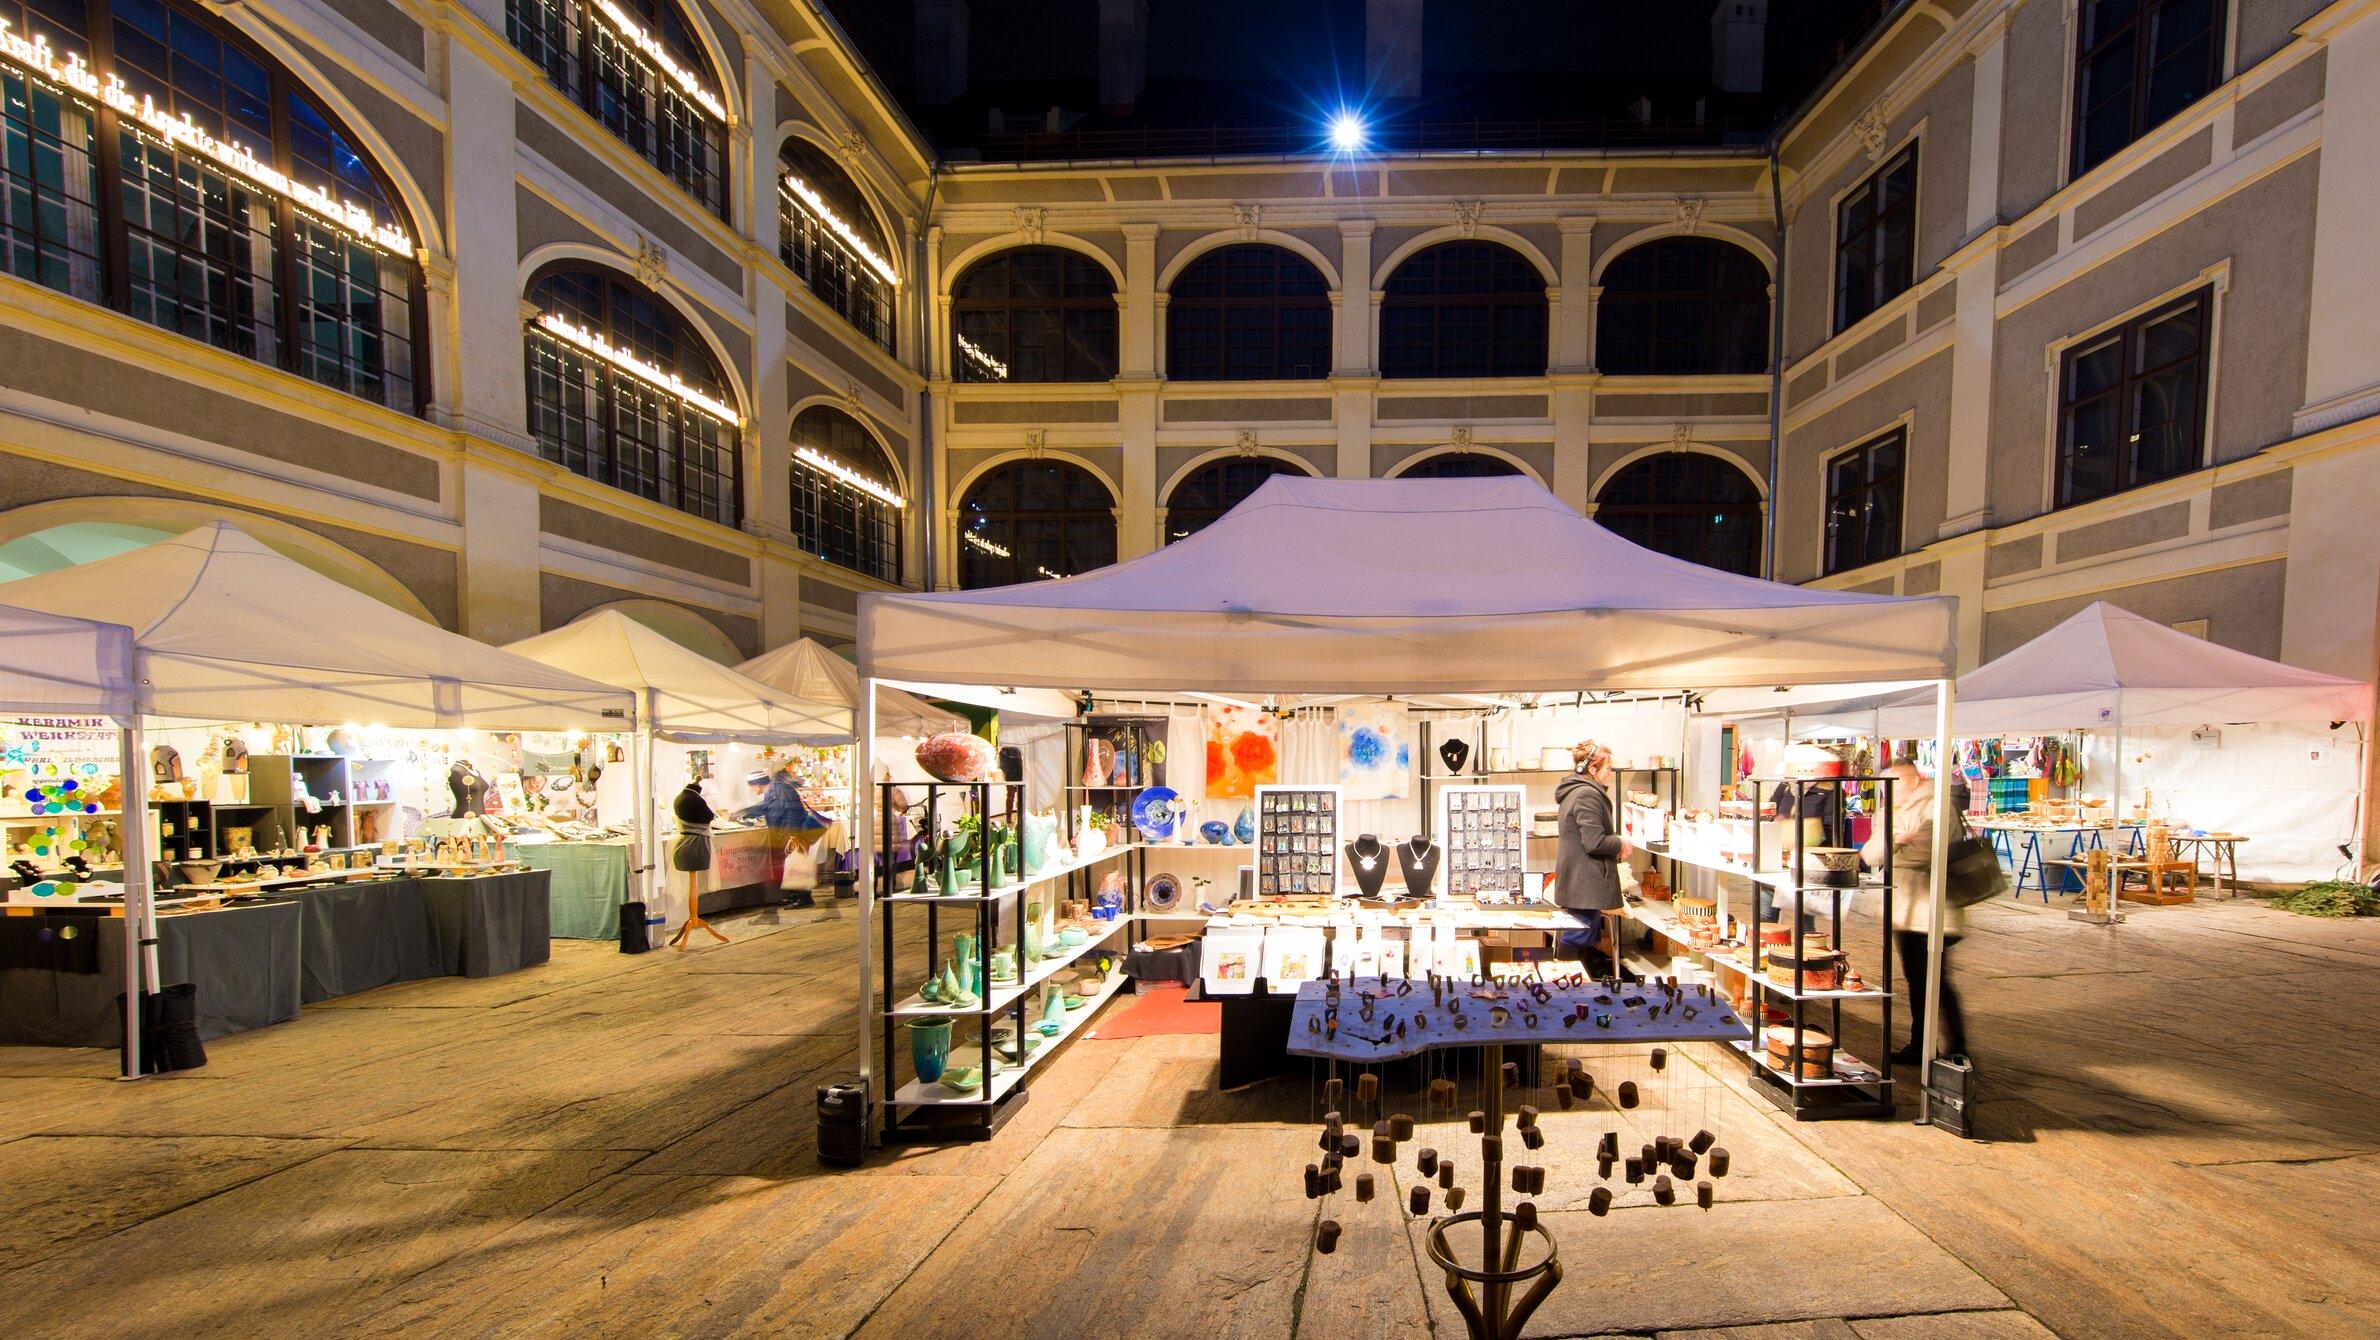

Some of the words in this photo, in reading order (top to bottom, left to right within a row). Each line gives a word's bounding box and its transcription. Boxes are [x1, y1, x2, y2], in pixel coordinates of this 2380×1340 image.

[66, 51, 99, 95] die
[104, 72, 136, 116] die
[20, 731, 118, 741] WERKSTAT
